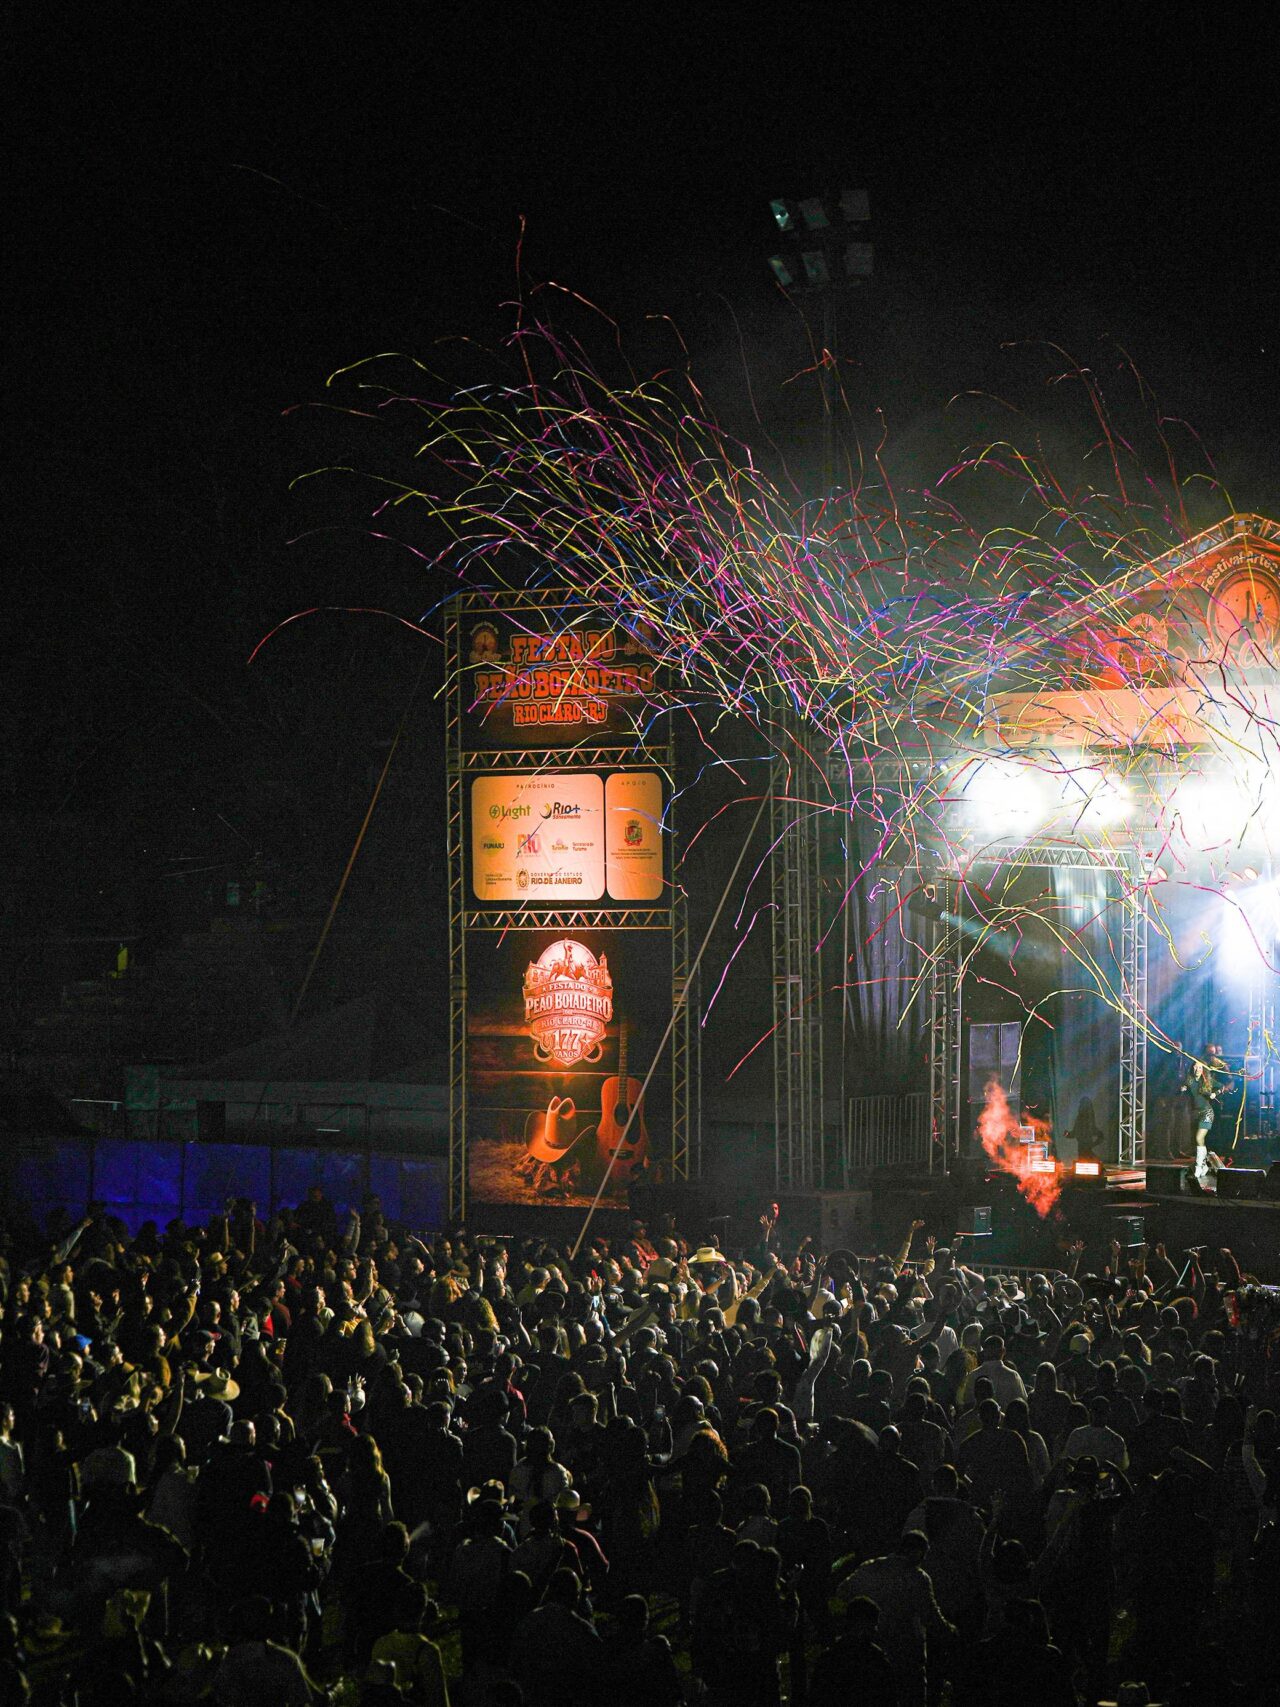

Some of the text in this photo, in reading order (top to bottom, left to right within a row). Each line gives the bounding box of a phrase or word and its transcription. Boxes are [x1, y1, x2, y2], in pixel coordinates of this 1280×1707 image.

[512, 633, 584, 662] FESTA
[587, 631, 616, 661] DO
[533, 665, 655, 698] BOIADEIRO
[514, 705, 537, 723] RIO
[554, 877, 583, 885] JANEIRO
[549, 982, 586, 991] FESTA DO
[525, 992, 611, 1020] PEÃO BOIADEIRO
[553, 1029, 580, 1050] 177
[556, 1050, 578, 1058] ANOS
